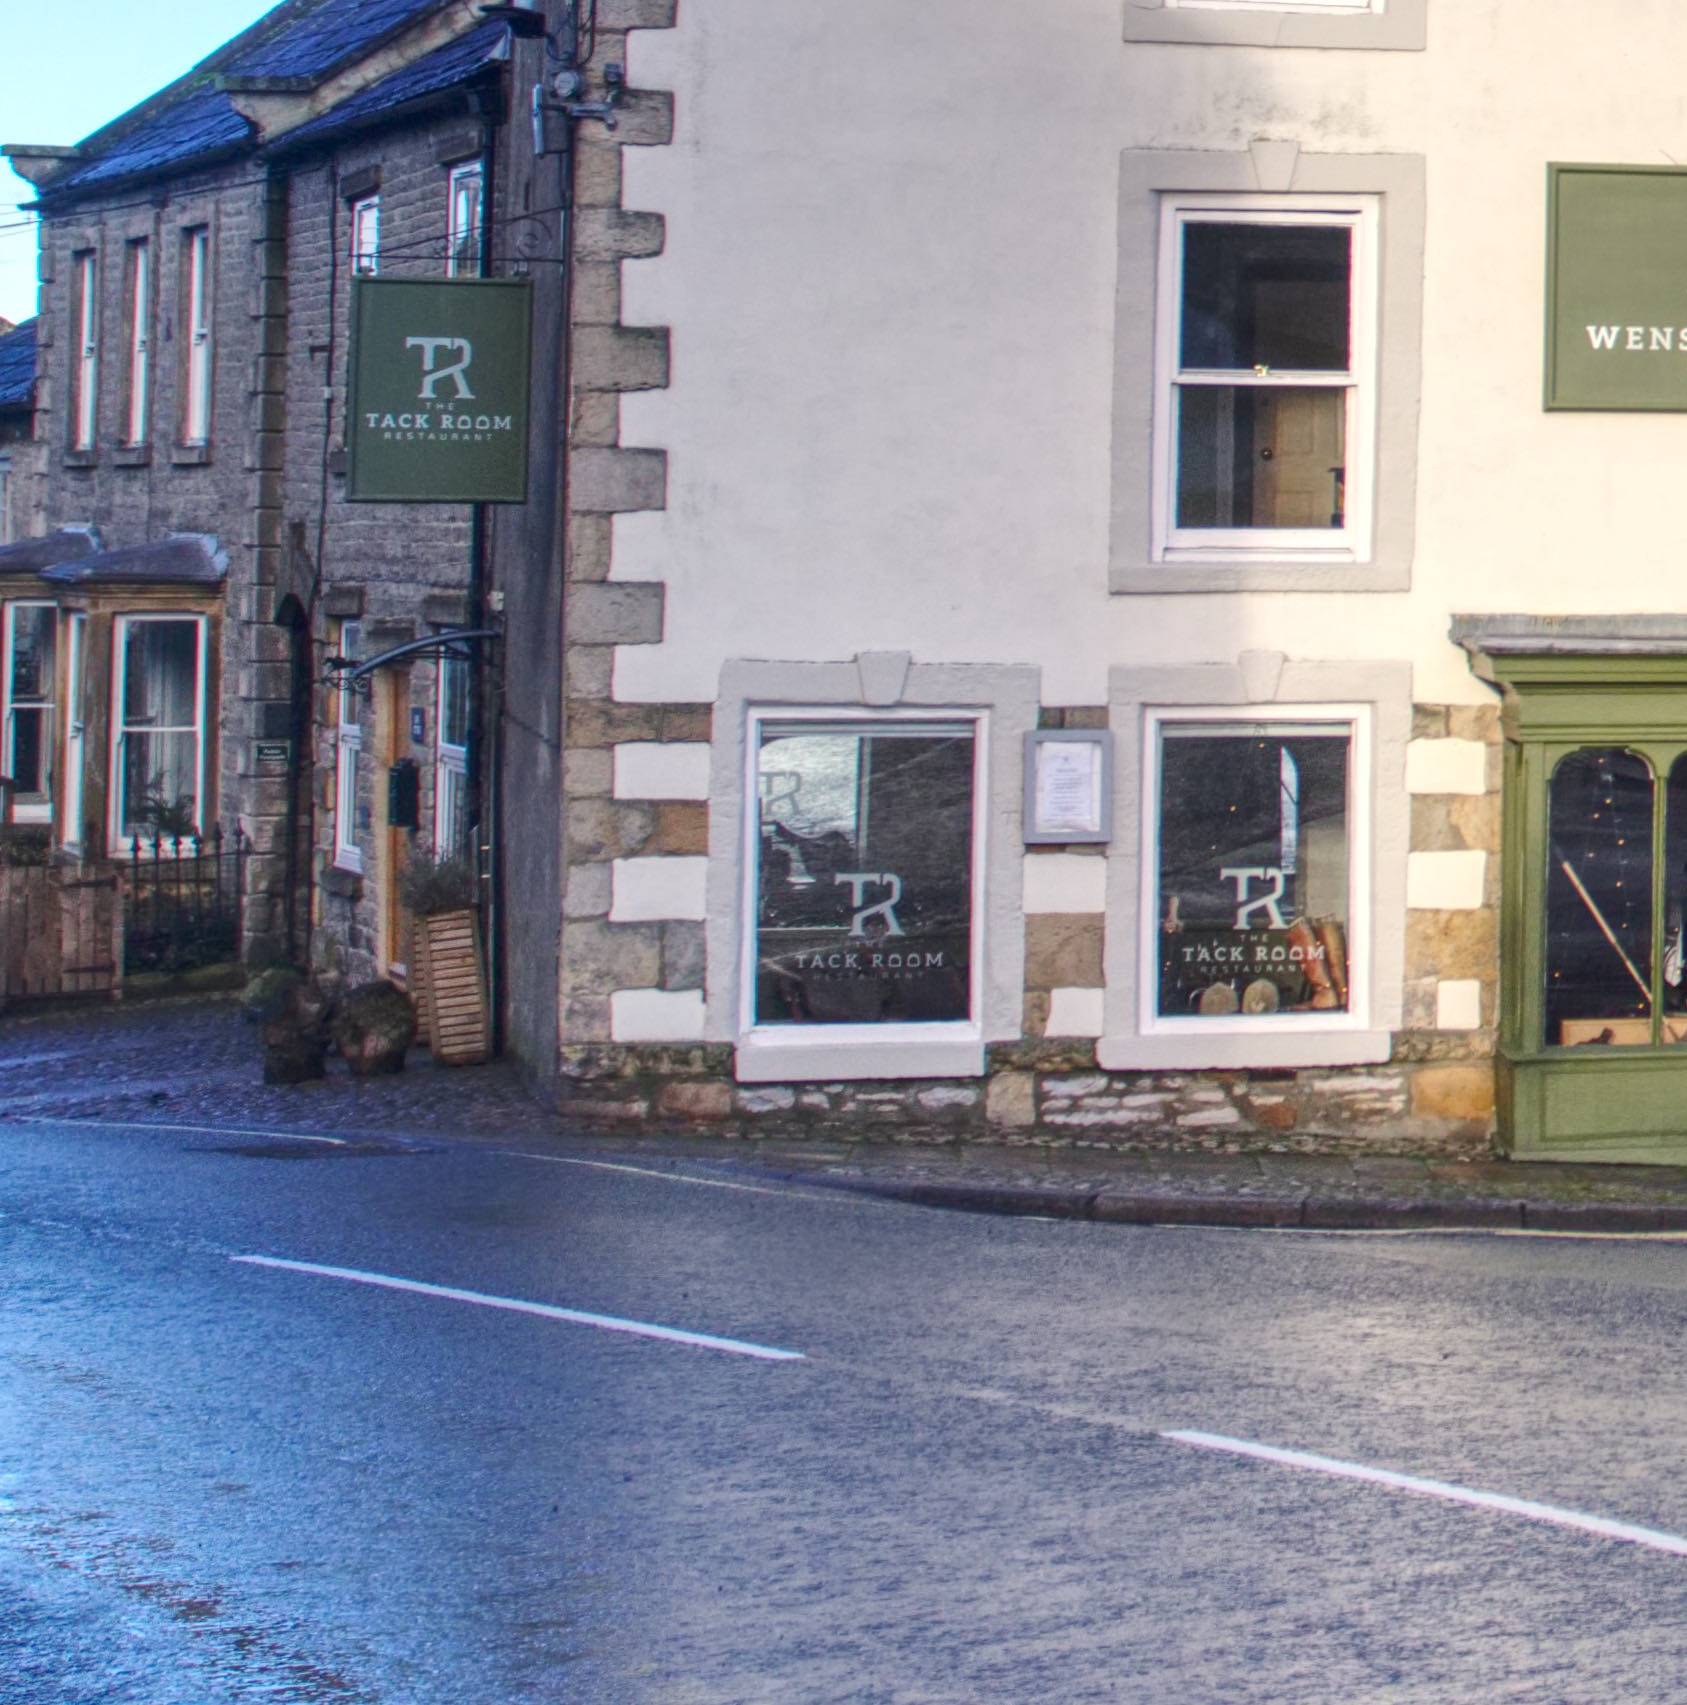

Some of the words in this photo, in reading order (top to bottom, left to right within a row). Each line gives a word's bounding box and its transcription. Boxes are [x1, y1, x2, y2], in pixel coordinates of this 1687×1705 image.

[425, 402, 456, 411] THE
[366, 413, 430, 429] TACK
[440, 414, 512, 430] ROOM
[384, 431, 493, 441] RESTAURANT
[1240, 934, 1269, 943] THE
[1182, 946, 1244, 962] TACK
[1255, 944, 1325, 962] ROOM
[795, 954, 859, 969] TACK
[872, 952, 944, 968] ROOM
